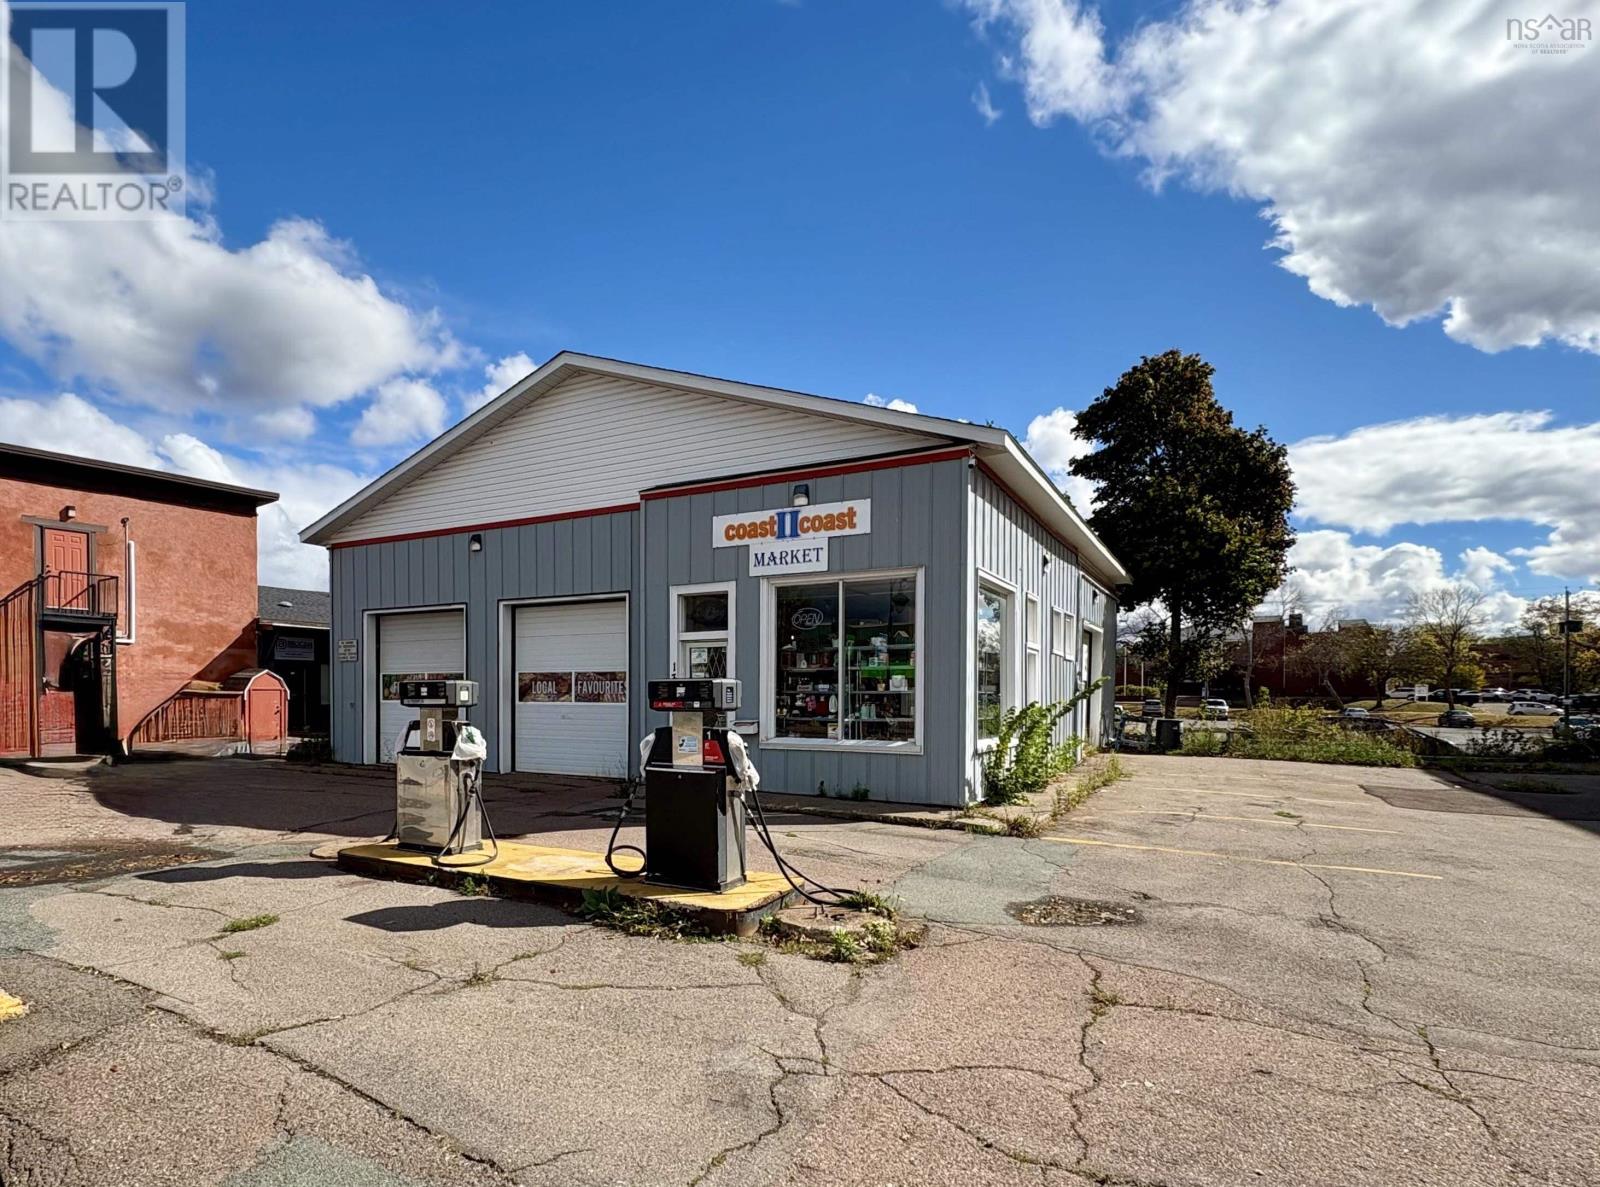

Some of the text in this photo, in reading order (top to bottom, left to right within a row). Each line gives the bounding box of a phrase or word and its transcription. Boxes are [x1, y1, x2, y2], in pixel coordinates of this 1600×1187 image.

[724, 515, 777, 541] coast
[799, 506, 857, 533] coast
[753, 547, 824, 568] MARKET
[794, 613, 821, 625] OPEN
[531, 681, 558, 694] LOCAL
